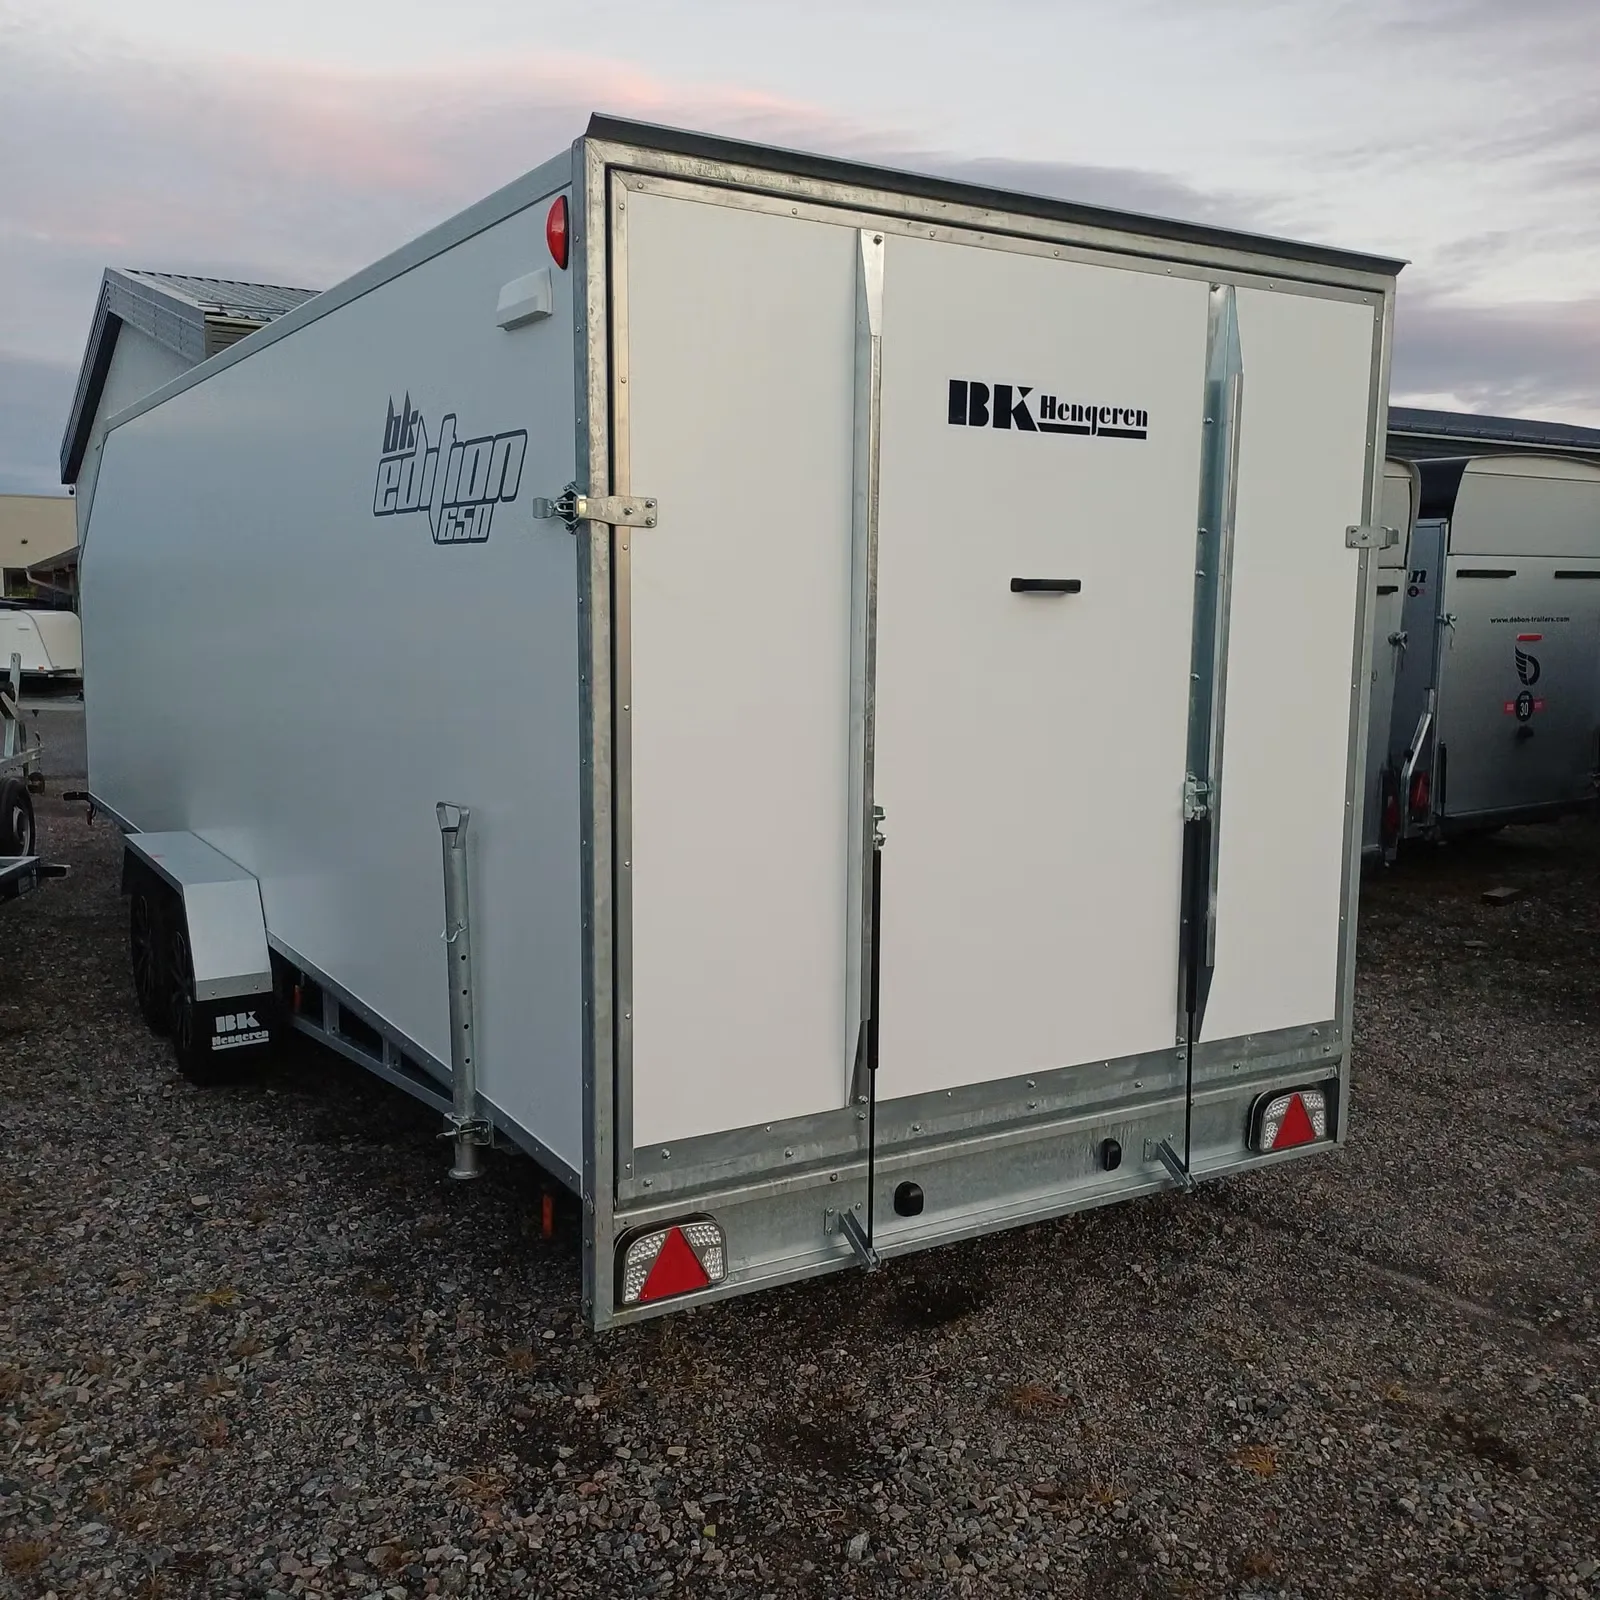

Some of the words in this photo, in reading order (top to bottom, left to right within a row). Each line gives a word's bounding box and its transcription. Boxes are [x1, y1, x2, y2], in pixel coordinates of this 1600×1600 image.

[383, 390, 418, 454] bk
[948, 379, 1038, 432] BK
[1040, 395, 1148, 436] Hengeren
[373, 413, 527, 544] edition
[437, 504, 494, 544] 650
[211, 1030, 269, 1047] Hengeren
[215, 1010, 260, 1033] BK
